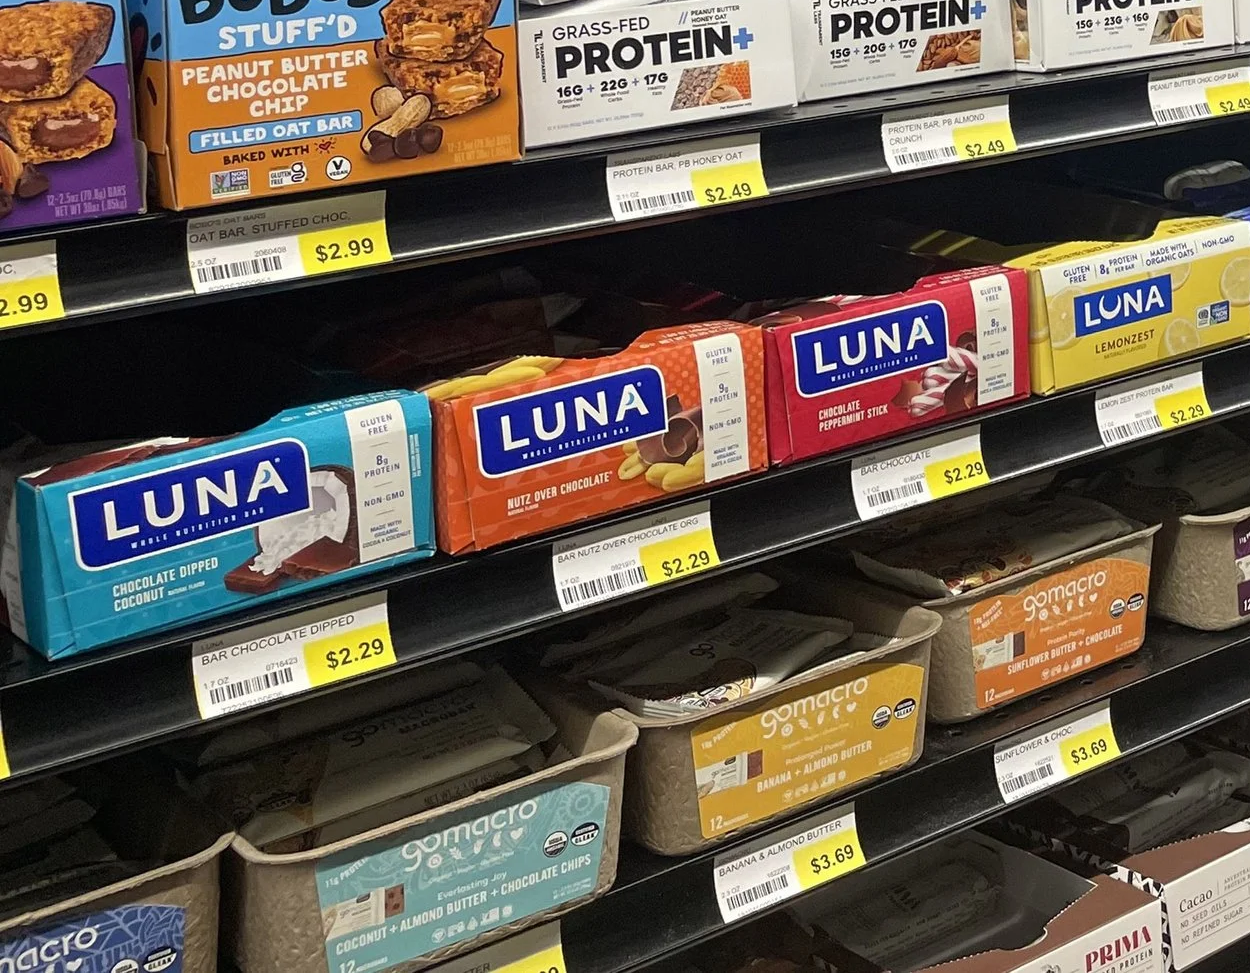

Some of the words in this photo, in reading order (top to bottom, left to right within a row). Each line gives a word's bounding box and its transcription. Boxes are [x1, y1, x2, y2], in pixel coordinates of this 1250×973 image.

[218, 14, 358, 50] STUFF'D
[552, 17, 650, 41] GRASS-FED
[181, 59, 274, 86] PEANUT
[280, 49, 369, 74] BUTTER
[206, 71, 348, 103] CHOCOLATE
[557, 84, 583, 98] 16G
[600, 79, 628, 92] 22G
[643, 72, 668, 86] 17G
[249, 95, 310, 118] CHIP
[200, 127, 267, 148] FILLED
[273, 121, 310, 138] OAT
[316, 116, 353, 134] BAR
[965, 139, 1005, 159] $2.49
[613, 165, 653, 179] PROTEIN
[679, 159, 691, 168] PB
[693, 154, 723, 167] HONEY
[725, 151, 742, 161] OAT
[705, 182, 752, 204] $2.49
[189, 232, 211, 244] OAT
[252, 218, 309, 234] STUFFED
[315, 238, 375, 263] $2.99
[1084, 284, 1165, 327] LUNA
[814, 316, 934, 374] LUNA
[1095, 329, 1155, 355] LEMONZEST
[360, 413, 393, 428] GLUTEN
[501, 383, 649, 452] LUNA
[819, 400, 860, 421] CHOCOLATE
[819, 410, 865, 433] PEPPERMINT
[867, 403, 888, 420] STICK
[1170, 405, 1204, 425] $2.29
[368, 424, 389, 435] FREE
[944, 461, 983, 484] $2.29
[103, 459, 288, 542] LUNA
[364, 490, 404, 507] NON-GMO
[507, 491, 531, 509] NUTZ
[534, 486, 557, 503] OVER
[560, 472, 610, 496] CHOCOLATE
[662, 550, 710, 576] $2.29
[113, 568, 176, 597] CHOCOLATE
[180, 558, 219, 580] DIPPED
[114, 587, 165, 612] COCONUT
[1023, 571, 1106, 622] gomacro
[201, 652, 229, 666] BAR
[230, 627, 308, 657] CHOCOLATE
[309, 615, 354, 634] DIPPED
[326, 639, 384, 669] $2.29
[1071, 739, 1107, 764] $3.69
[719, 856, 757, 877] BANANA
[759, 850, 765, 860] &
[767, 836, 805, 856] ALMOND
[807, 820, 842, 842] BUTTER
[811, 845, 854, 875] $3.69
[1179, 888, 1213, 913] Cacao
[1180, 920, 1189, 929] NO
[1192, 911, 1208, 924] SEED
[1211, 899, 1227, 913] OILS
[1181, 935, 1190, 945] NO
[1193, 919, 1221, 939] REFINED
[1223, 907, 1243, 922] SUGAR
